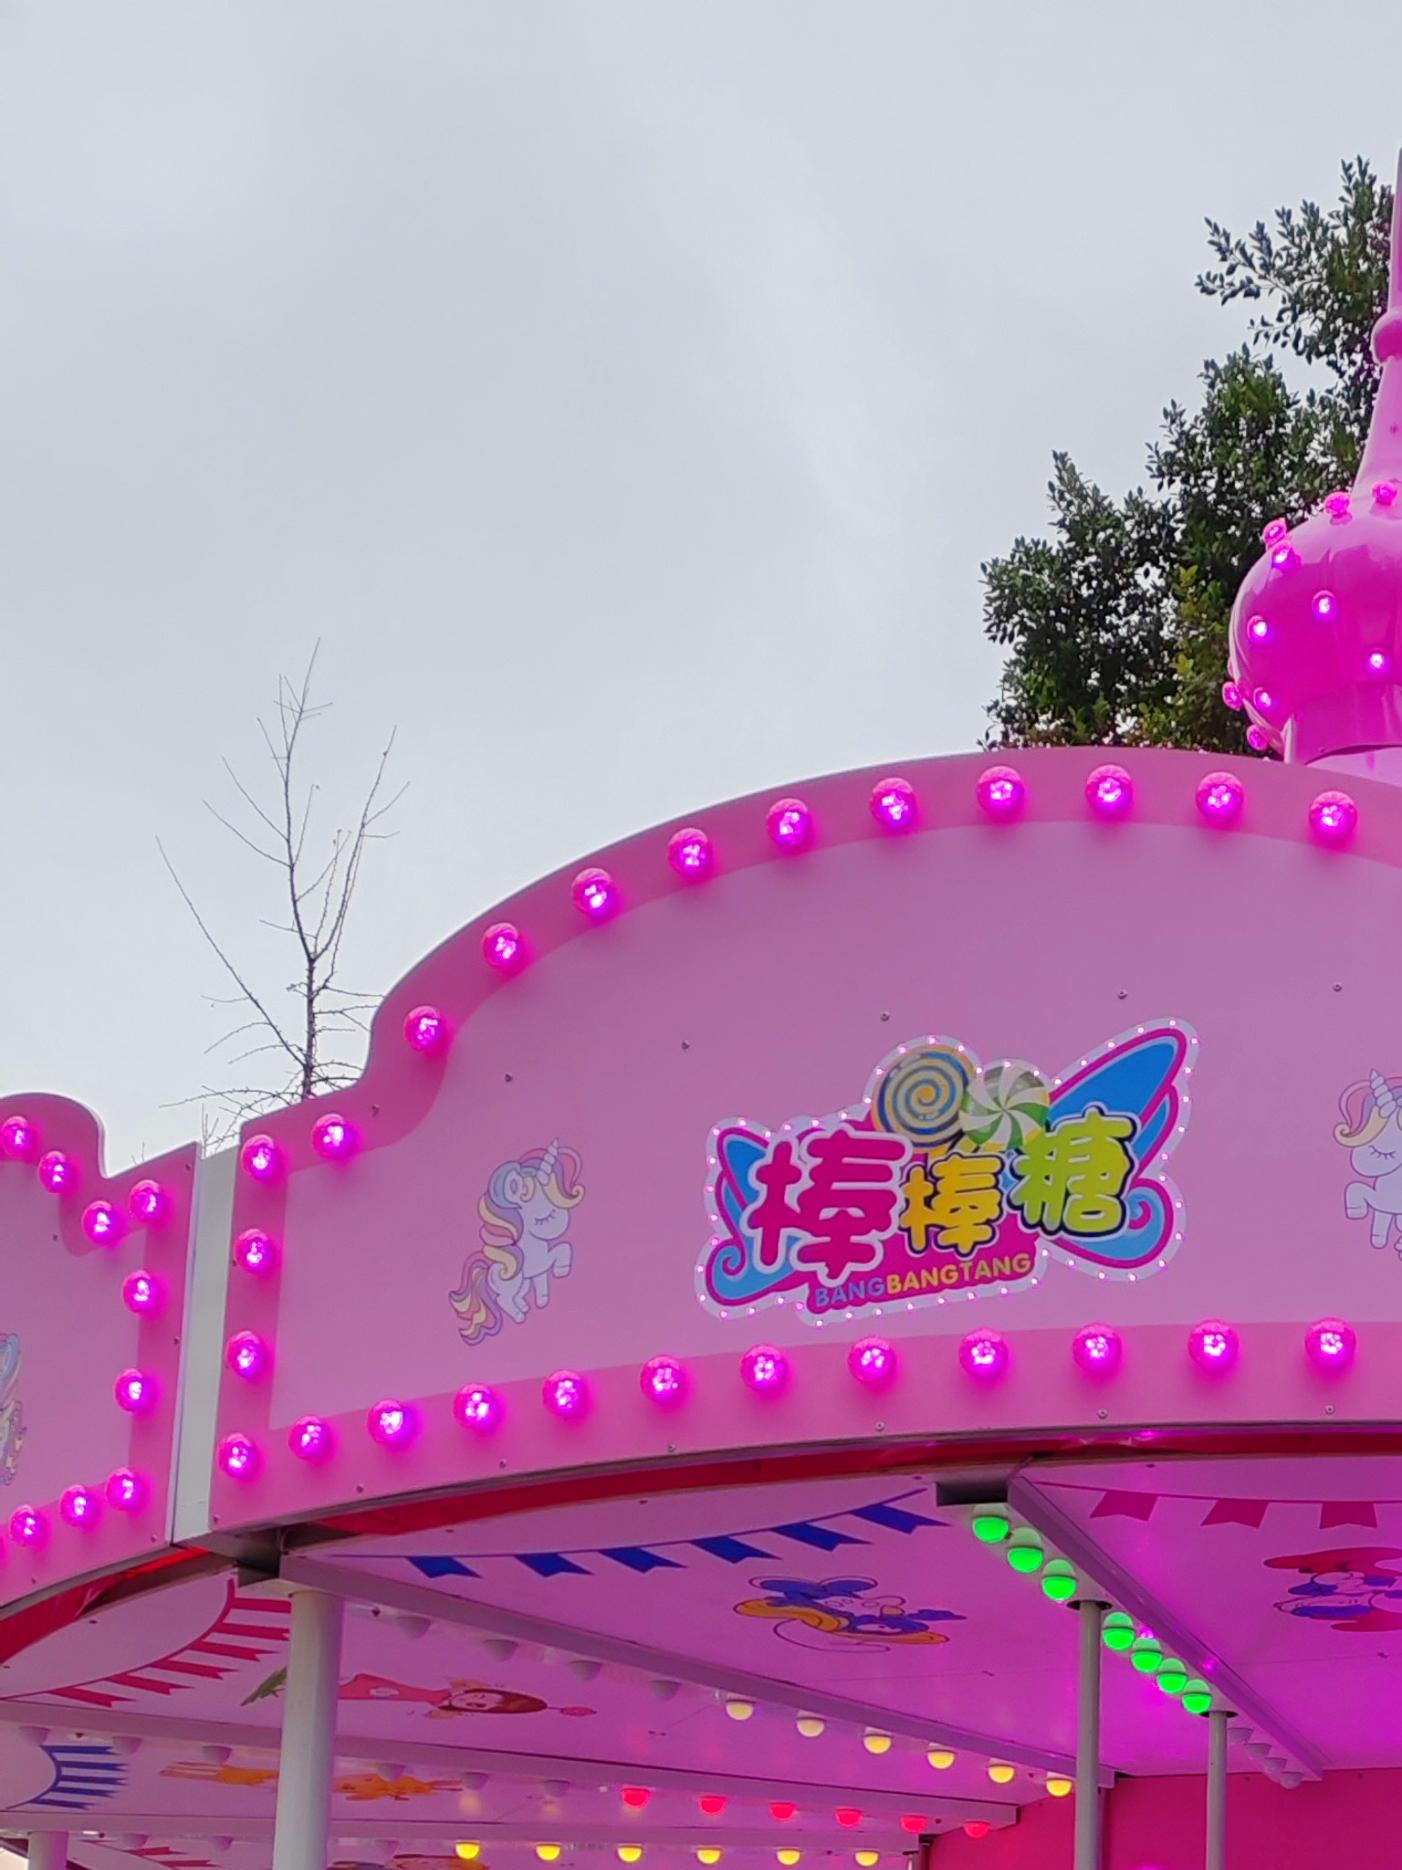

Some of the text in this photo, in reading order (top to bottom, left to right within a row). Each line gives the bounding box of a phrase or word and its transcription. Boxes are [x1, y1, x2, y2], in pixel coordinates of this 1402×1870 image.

[746, 1107, 1136, 1278] 棒棒糖
[815, 1251, 1031, 1307] BANGBANGTANG
